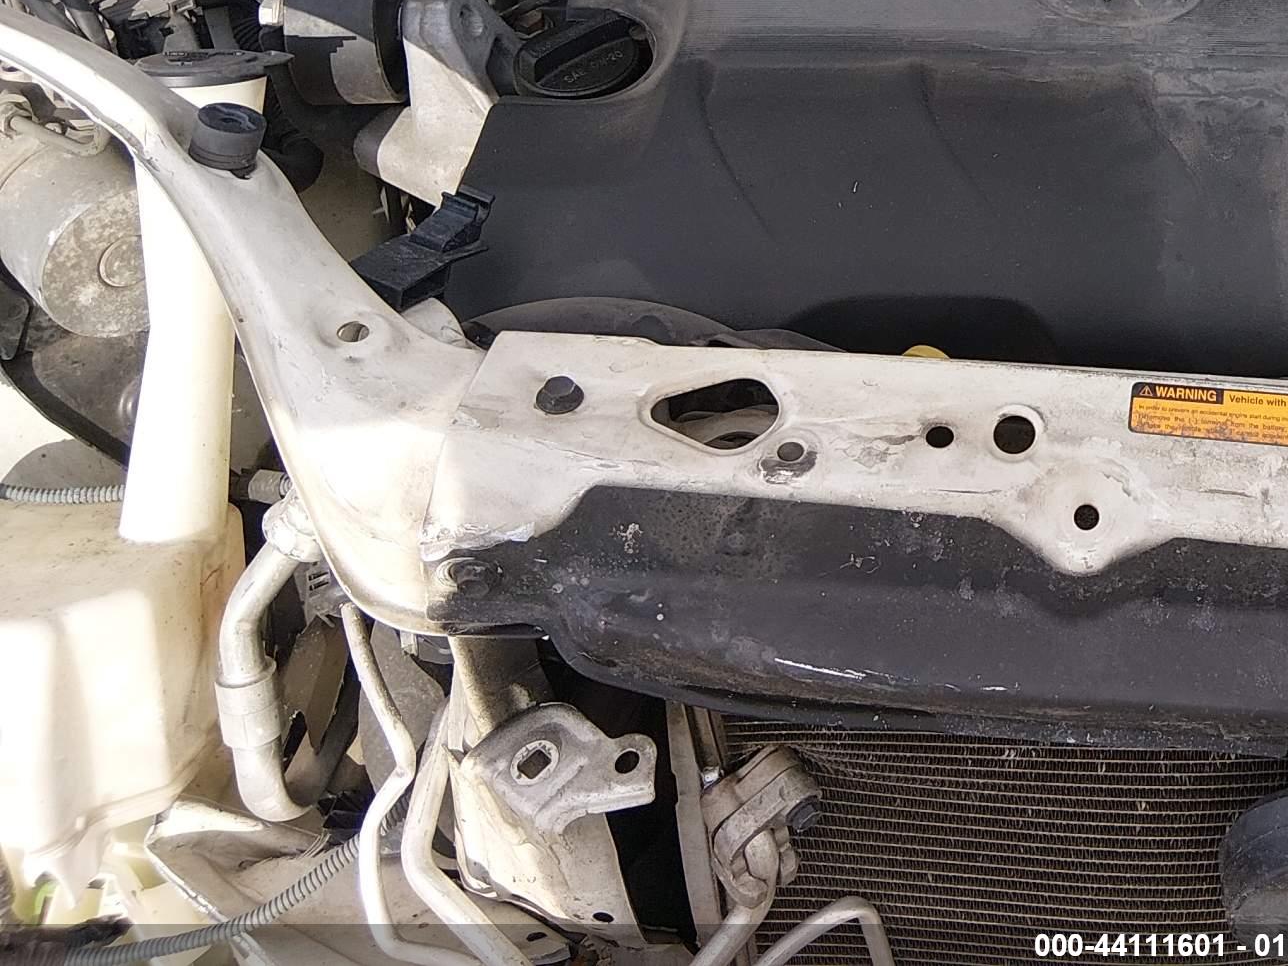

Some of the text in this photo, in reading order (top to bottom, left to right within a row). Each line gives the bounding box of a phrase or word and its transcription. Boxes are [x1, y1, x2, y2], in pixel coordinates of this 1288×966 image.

[1155, 385, 1217, 402] WARNING
[1229, 394, 1264, 405] Vehicle
[1266, 398, 1287, 407] with
